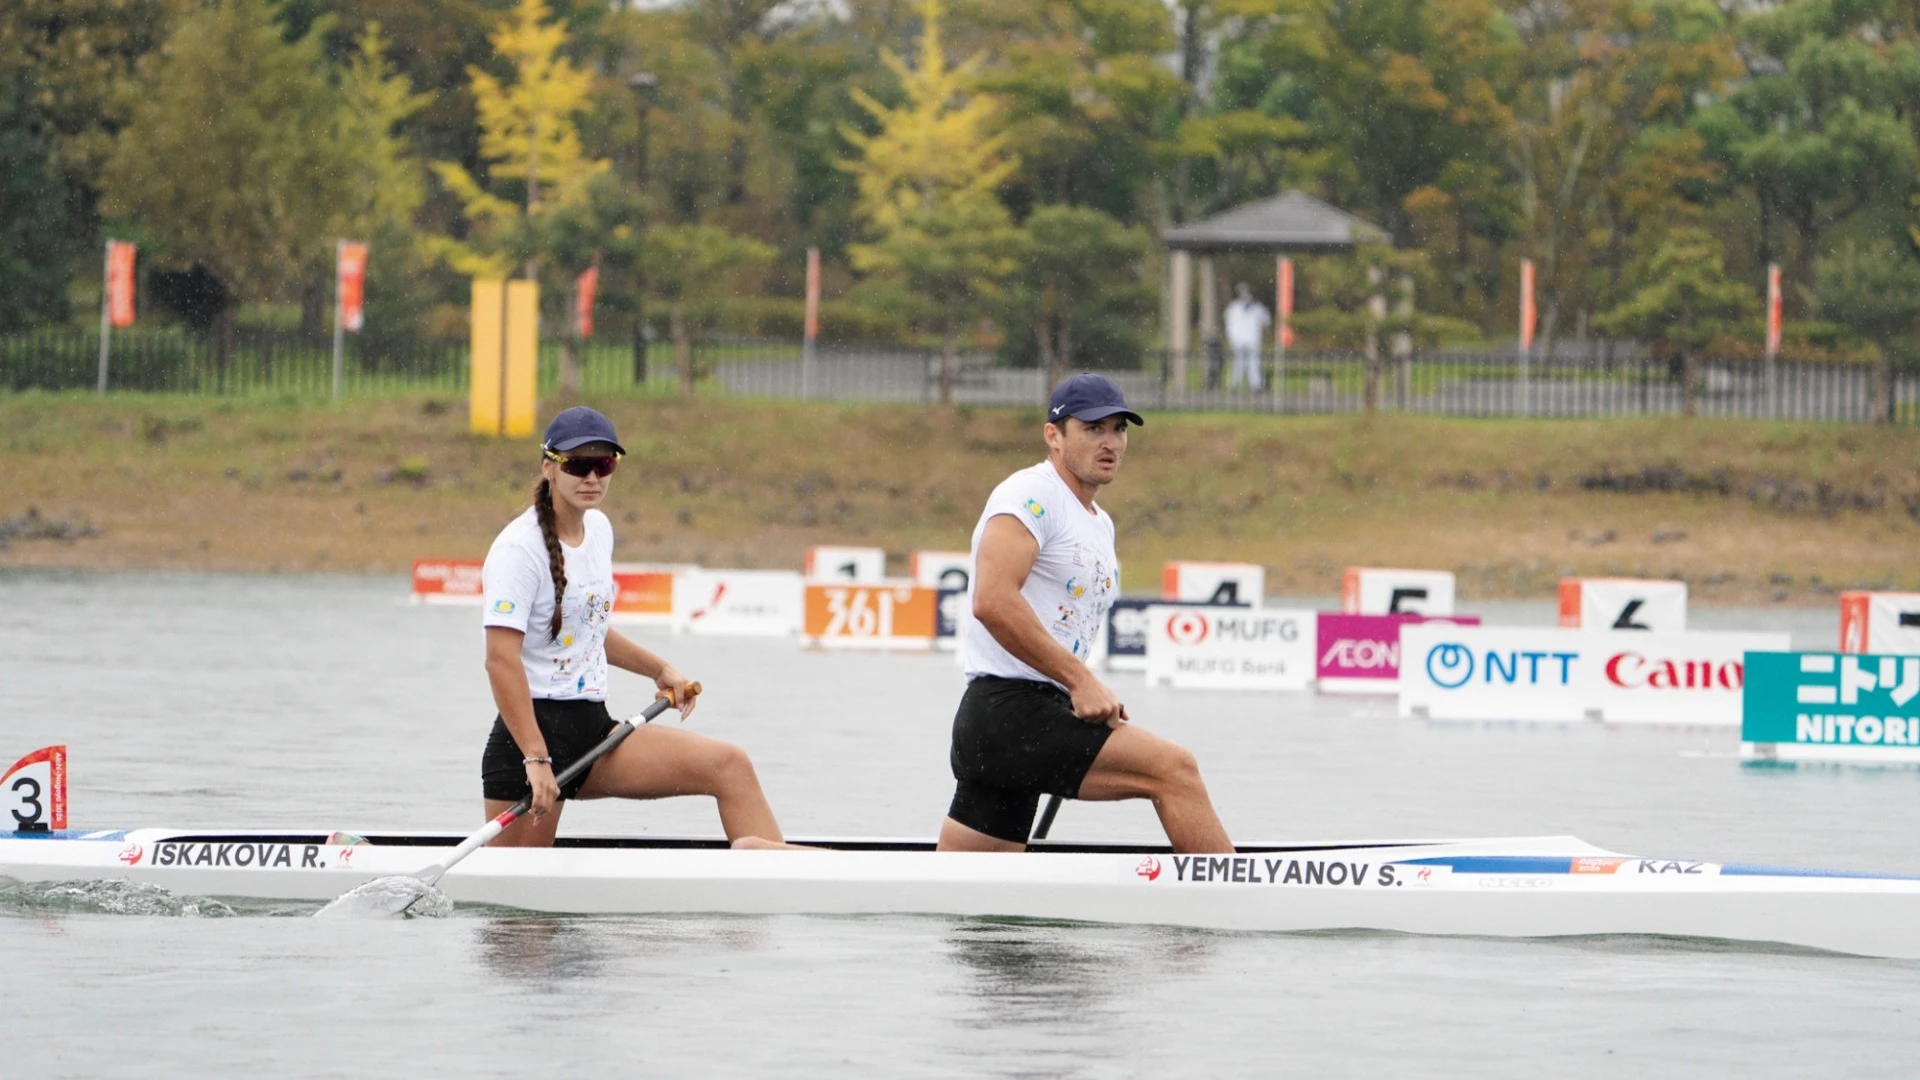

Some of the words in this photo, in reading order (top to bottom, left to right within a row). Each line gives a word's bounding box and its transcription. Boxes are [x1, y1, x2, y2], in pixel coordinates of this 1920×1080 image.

[1216, 619, 1298, 642] MUFG
[1177, 659, 1235, 677] MUFG
[1243, 660, 1287, 677] Bank
[1485, 651, 1579, 684] NTT
[1605, 651, 1743, 691] Cano
[1797, 655, 1920, 707] ニトリ
[1796, 713, 1920, 744] NITORI
[11, 777, 42, 823] 3
[151, 843, 292, 867] ISKAKOVA
[301, 845, 326, 868] R.
[1638, 860, 1703, 875] KAZ
[1173, 856, 1368, 886] YEMELYANOV
[1377, 865, 1403, 887] S.
